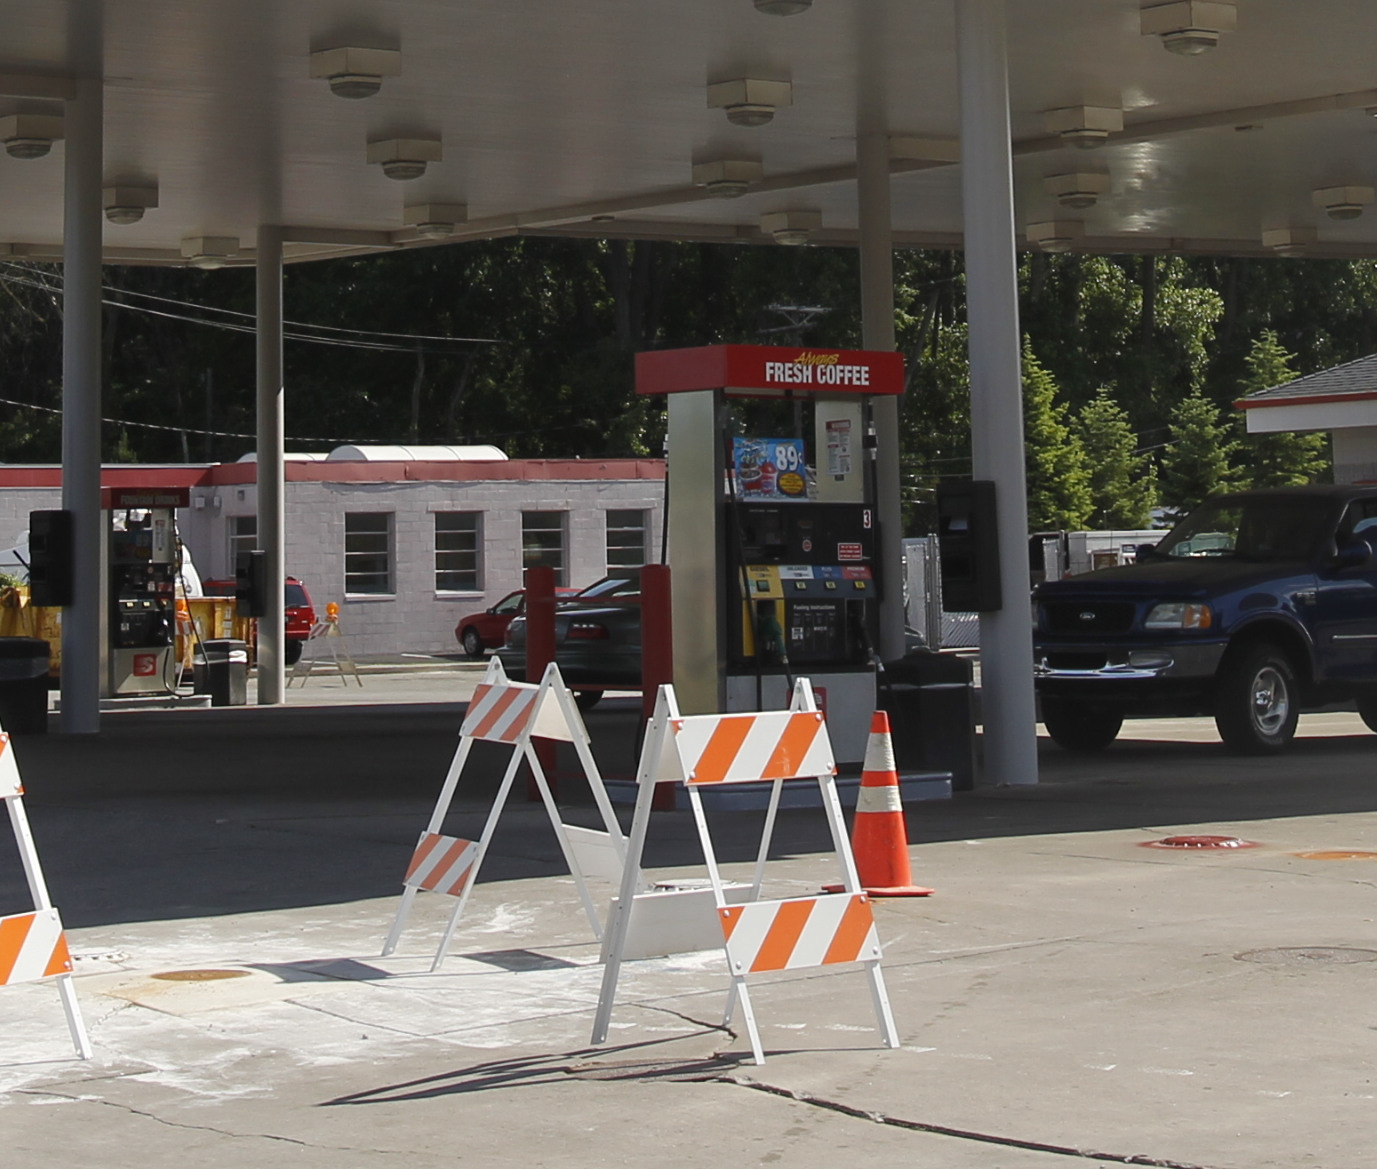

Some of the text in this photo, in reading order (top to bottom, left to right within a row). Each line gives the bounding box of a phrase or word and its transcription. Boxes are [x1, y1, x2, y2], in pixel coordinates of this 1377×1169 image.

[765, 362, 870, 386] FRESH COFFEE
[864, 510, 871, 528] 3
